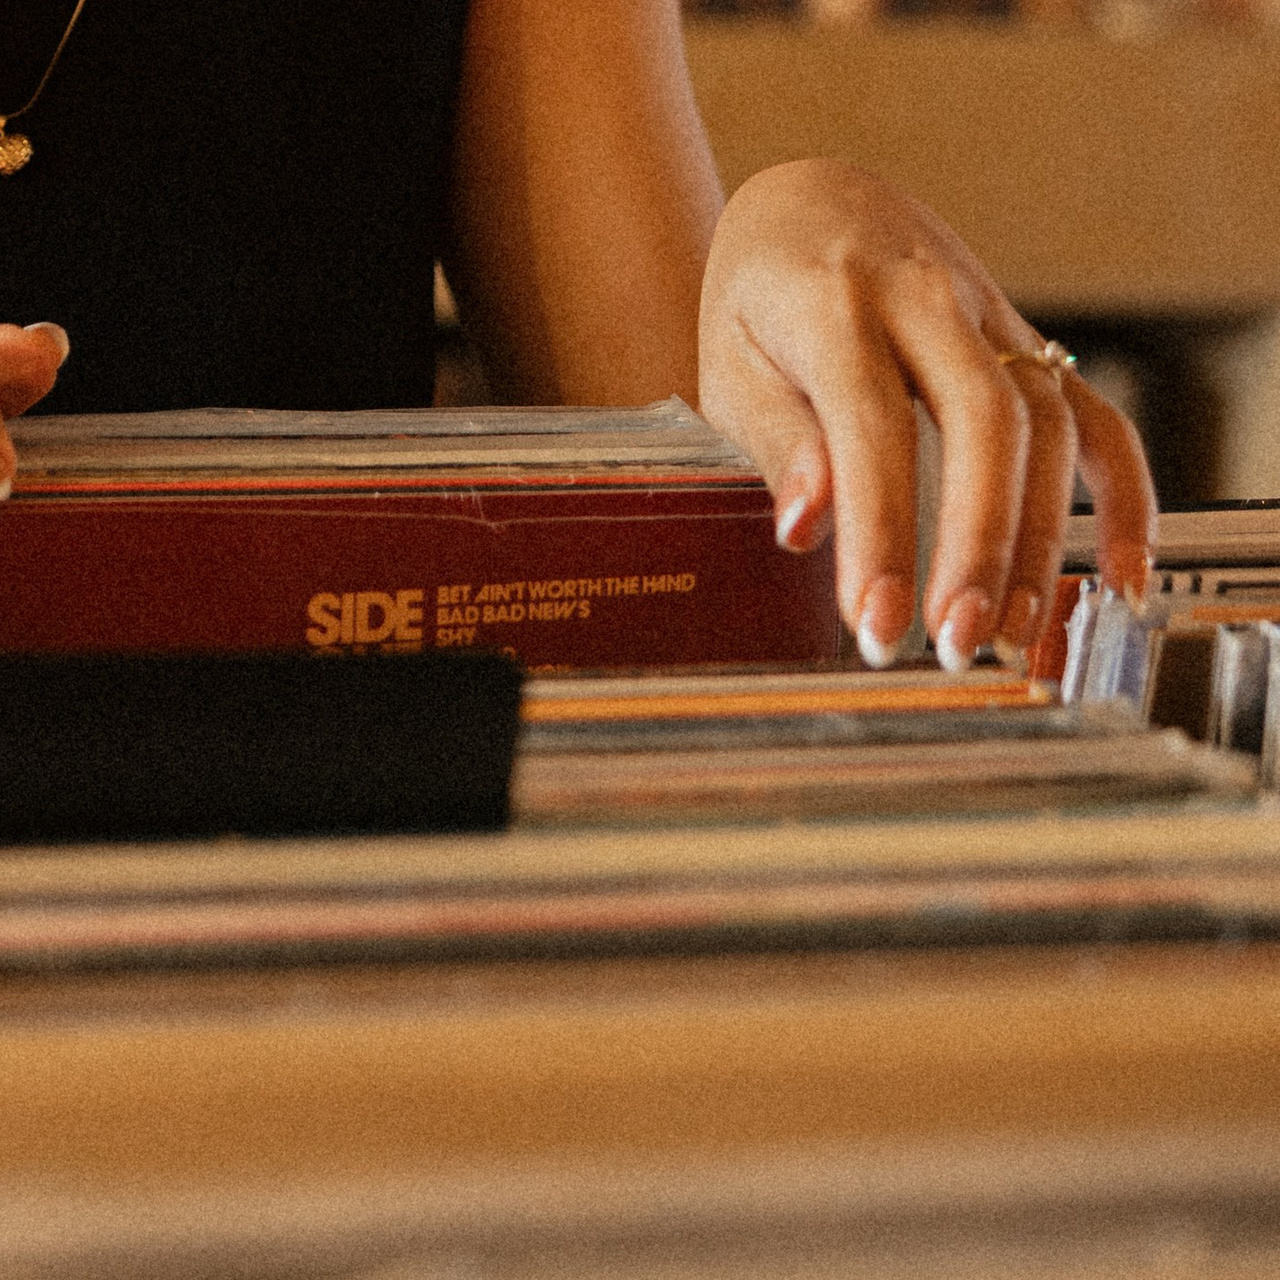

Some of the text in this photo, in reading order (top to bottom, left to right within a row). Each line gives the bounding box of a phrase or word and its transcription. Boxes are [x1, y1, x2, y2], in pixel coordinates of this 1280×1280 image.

[437, 573, 696, 605] BET AIN'T WORTH THE HAND
[306, 589, 423, 645] SIDE
[436, 605, 479, 625] BAD
[482, 603, 526, 623] BAD
